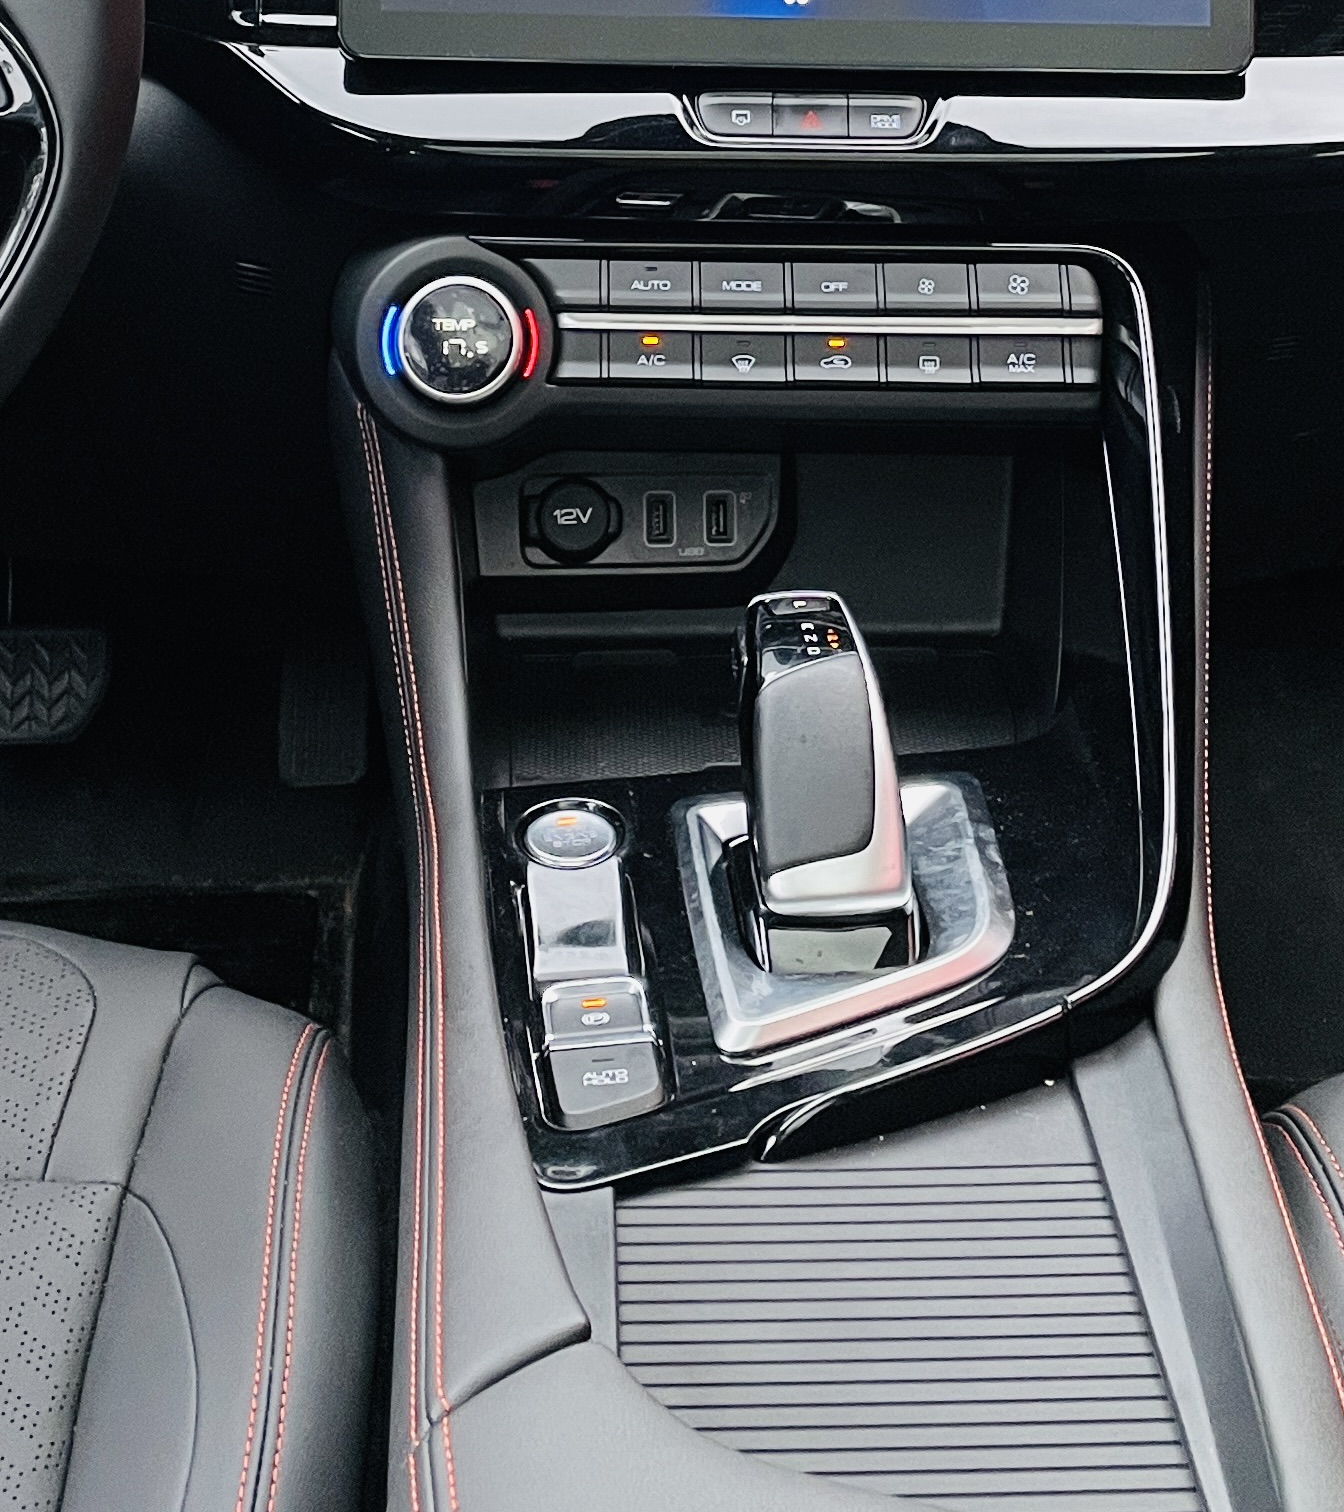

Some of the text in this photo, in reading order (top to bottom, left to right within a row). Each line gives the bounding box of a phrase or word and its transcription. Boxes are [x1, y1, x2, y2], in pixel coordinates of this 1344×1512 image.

[630, 280, 672, 291] AUTO
[722, 280, 763, 292] MODE
[820, 282, 849, 293] OFF
[431, 318, 477, 332] TEMP
[636, 354, 667, 367] A/C
[1006, 353, 1037, 366] A/C
[1008, 364, 1035, 374] MAX
[553, 507, 594, 525] 12V
[582, 1068, 628, 1078] AUTO
[582, 1075, 629, 1087] HOLD
